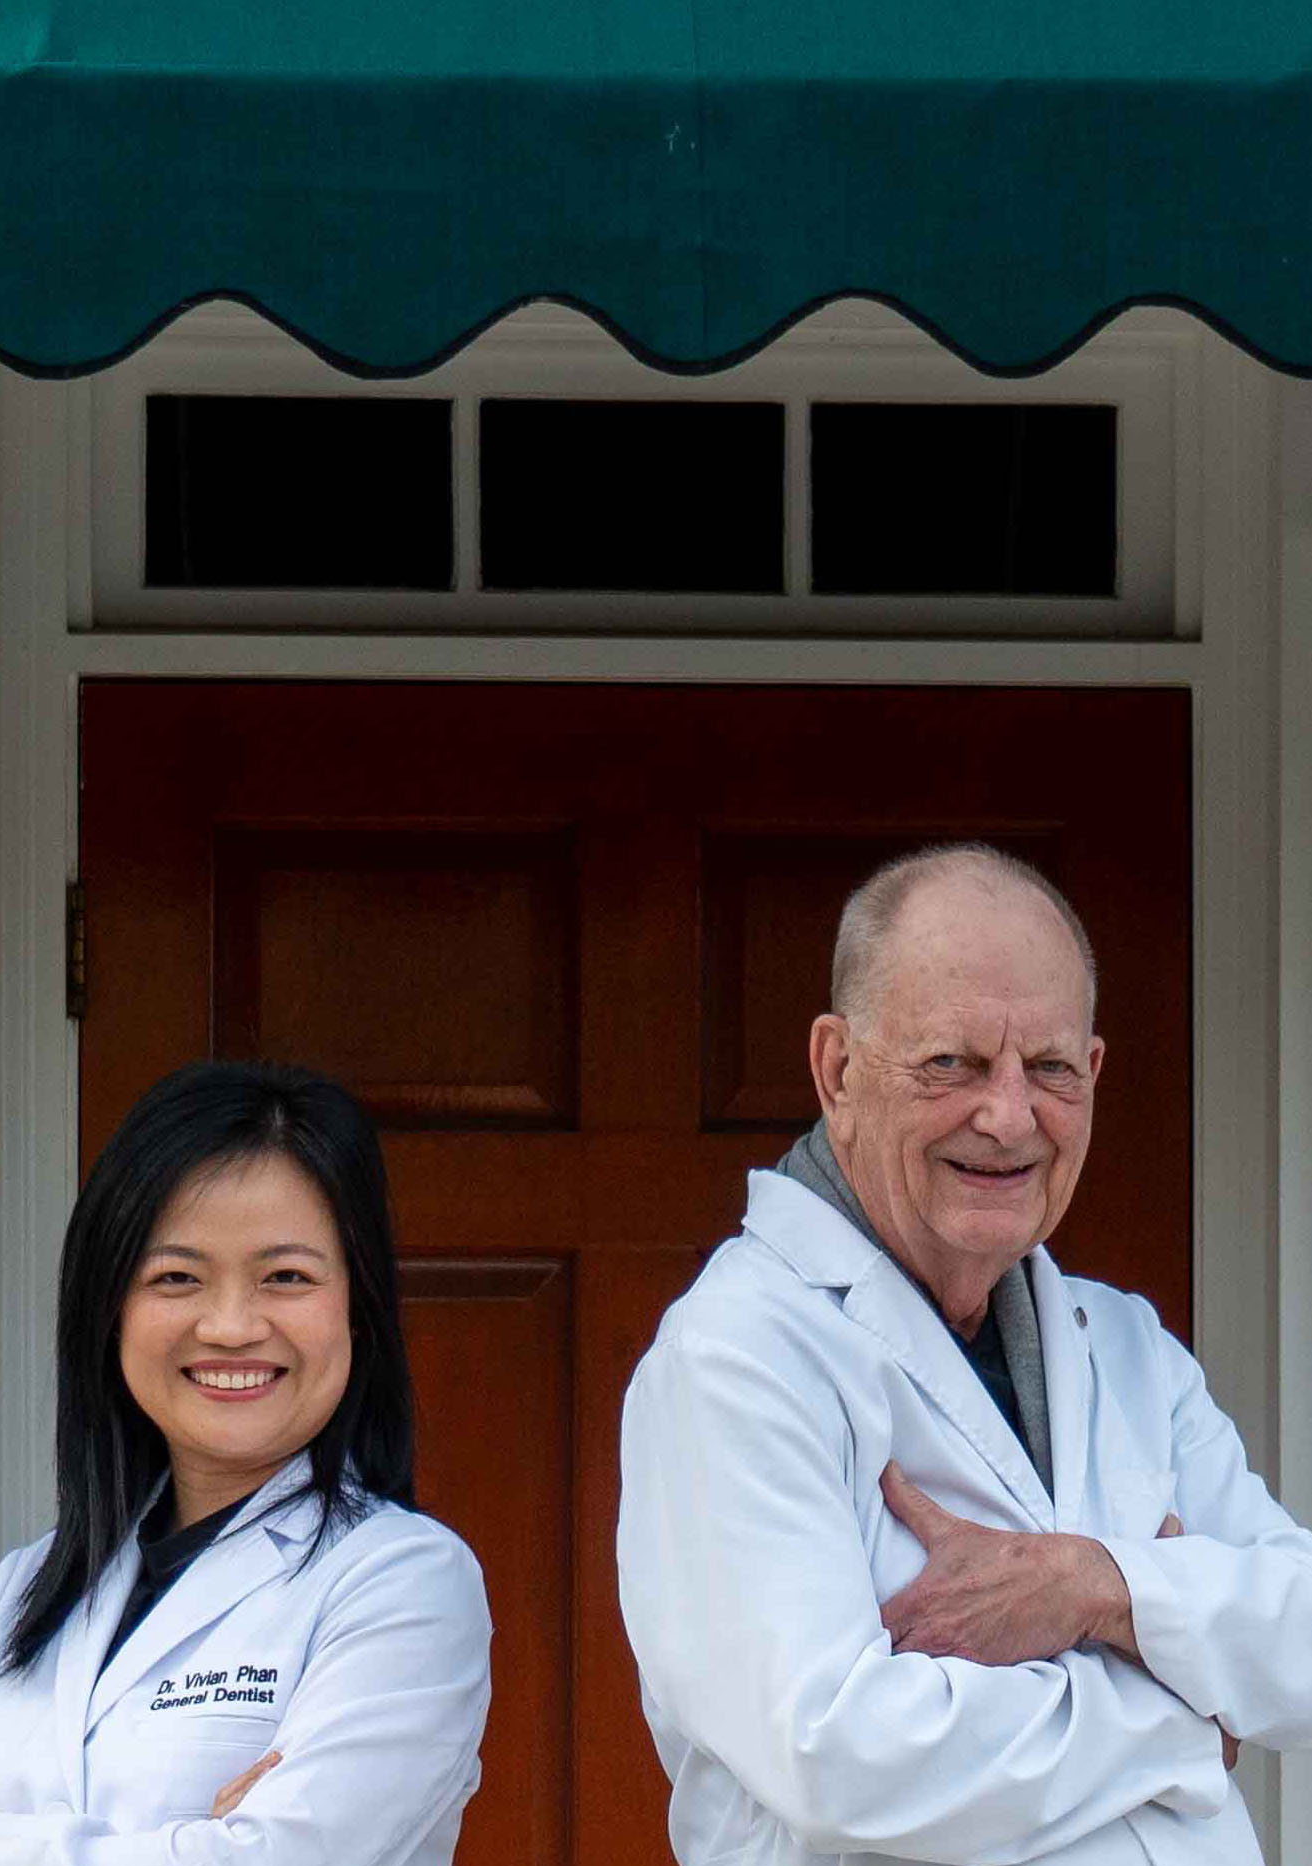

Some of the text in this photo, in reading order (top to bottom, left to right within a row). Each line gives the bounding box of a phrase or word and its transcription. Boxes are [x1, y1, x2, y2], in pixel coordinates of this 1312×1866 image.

[157, 1665, 278, 1695] Dr. Vivian Phan
[150, 1687, 275, 1711] General Dentist
